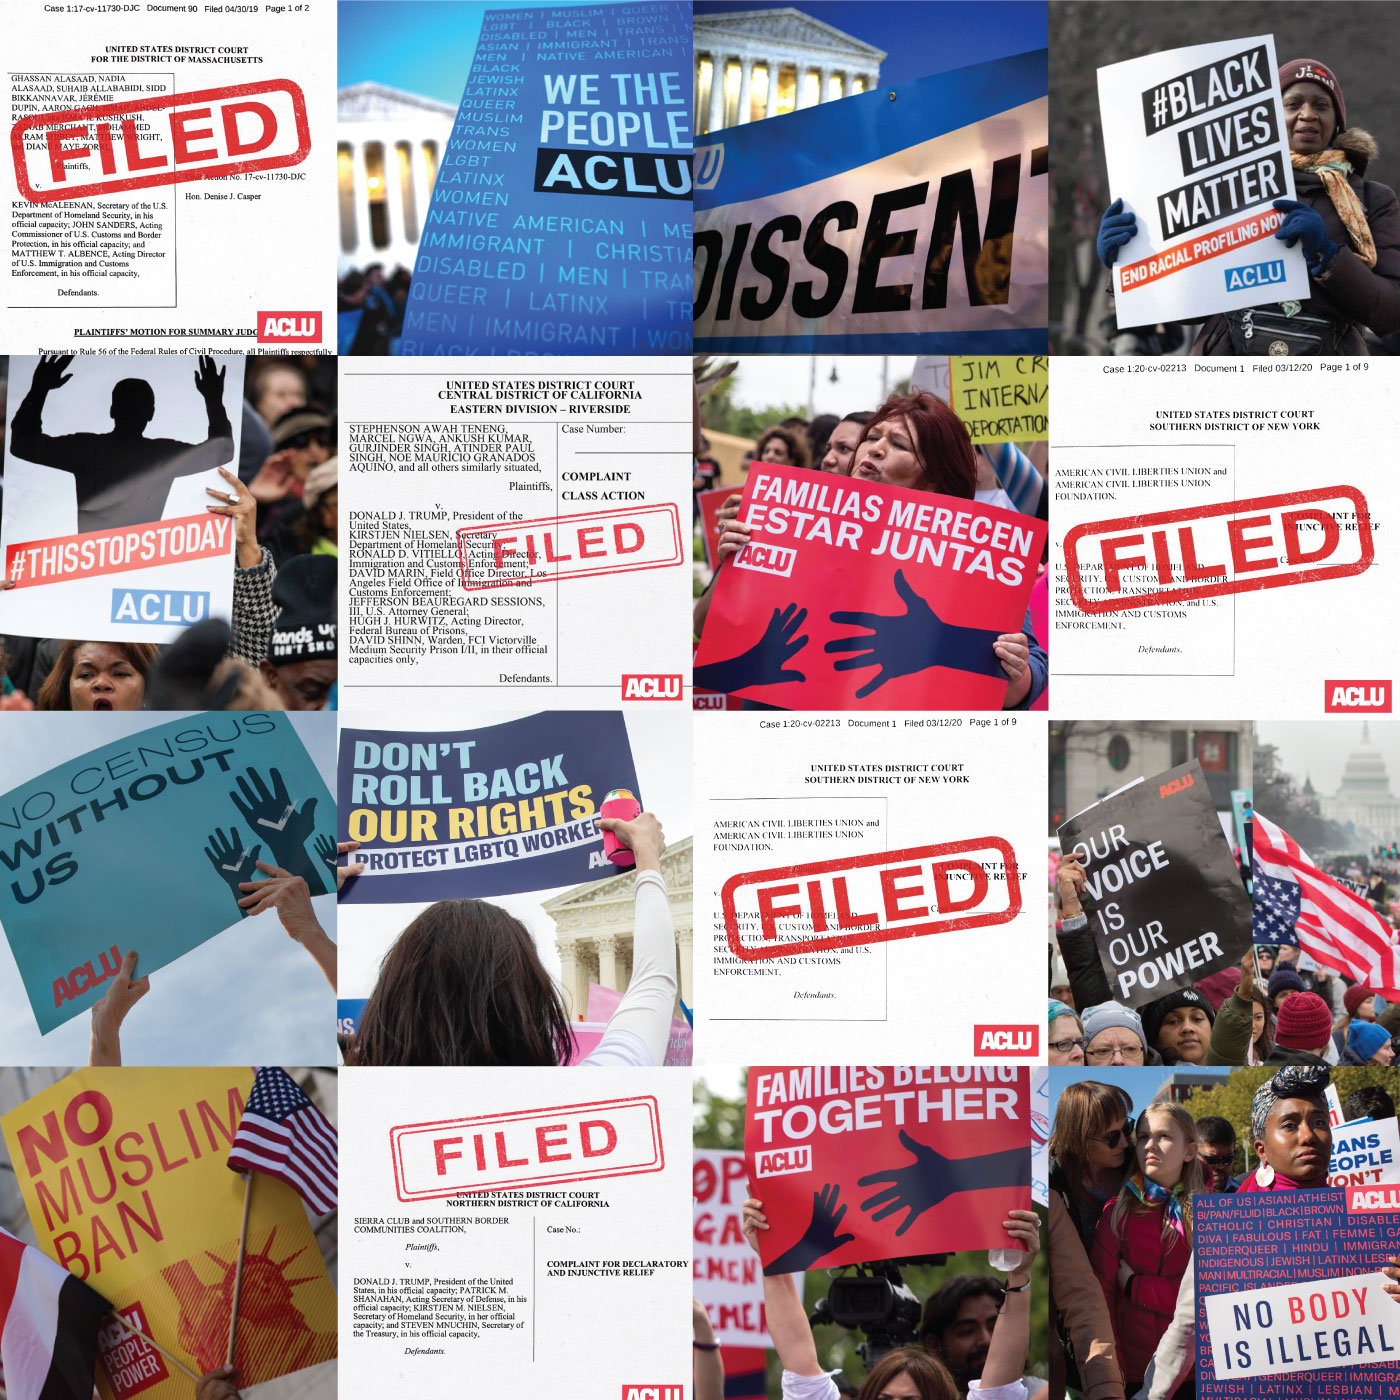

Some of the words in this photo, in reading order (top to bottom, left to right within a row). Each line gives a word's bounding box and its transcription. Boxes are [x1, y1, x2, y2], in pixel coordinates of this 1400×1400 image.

[544, 74, 601, 105] WE
[612, 72, 686, 106] THE
[1153, 51, 1264, 128] #BLACK
[46, 101, 277, 183] FILED
[540, 110, 693, 149] PEOPLE
[1188, 106, 1270, 168] LIVES
[543, 154, 693, 194] ACLU
[185, 192, 200, 200] Hon.
[204, 192, 228, 200] Denise
[229, 192, 233, 200] J.
[236, 192, 262, 202] Casper
[1164, 159, 1279, 234] MATTER
[430, 210, 499, 228] NATIVE
[513, 215, 625, 235] AMERICAN
[1122, 265, 1147, 287] END
[1149, 247, 1192, 276] RACIAL
[1194, 221, 1259, 259] PROFILING
[1229, 263, 1282, 289] ACLU
[264, 318, 316, 338] ACLU
[962, 359, 1000, 381] JIM
[561, 424, 584, 434] Case
[586, 424, 626, 434] Number:
[1149, 422, 1202, 431] SOUTHERN
[1204, 422, 1250, 431] DISTRICT
[1251, 423, 1266, 431] OF
[1267, 422, 1290, 431] NEW
[1292, 422, 1320, 431] YORK
[561, 471, 632, 481] COMPLAINT
[561, 491, 598, 501] CLASS
[600, 491, 645, 501] ACTION
[751, 475, 884, 522] FAMILIAS
[887, 500, 1033, 556] MERECEN
[10, 519, 230, 581] #THISSTOPSTODAY
[493, 522, 646, 568] FILED
[736, 547, 794, 573] ACLU
[745, 505, 864, 550] ESTAR
[870, 529, 1026, 587] JUNTAS
[1100, 509, 1340, 592] FILED
[116, 593, 204, 622] ACLU
[625, 678, 679, 697] ACLU
[1331, 685, 1385, 706] ACLU
[71, 713, 277, 795] CENSUS
[354, 740, 476, 771] DON'T
[352, 773, 452, 805] ROLL
[464, 754, 569, 802] BACK
[1159, 774, 1194, 798] ACLU
[348, 808, 438, 843] OUR
[448, 784, 596, 840] RIGHTS
[356, 850, 450, 871] PROTECT
[454, 839, 519, 865] LGBTQ
[1085, 840, 1170, 901] VOICE
[10, 851, 79, 905] US
[757, 859, 989, 940] FILED
[52, 945, 123, 1009] ACLU
[1118, 932, 1224, 999] POWER
[980, 1031, 1032, 1051] ACLU
[757, 1066, 885, 1106] FAMILIES
[16, 1090, 113, 1178] NO
[755, 1088, 1019, 1143] TOGETHER
[35, 1087, 245, 1232] MUSLIM
[433, 1120, 618, 1176] FILED
[759, 1150, 808, 1175] ACLU
[53, 1190, 164, 1281] BAN
[546, 1260, 601, 1268] COMPLAINT
[602, 1260, 621, 1268] FOR
[622, 1260, 689, 1268] DECLARATORY
[1233, 1299, 1275, 1331] NO
[1288, 1287, 1369, 1324] BODY
[104, 1337, 152, 1373] PEOPLE
[1224, 1340, 1252, 1370] IS
[1266, 1324, 1394, 1366] ILLEGAL
[112, 1355, 160, 1392] POWER
